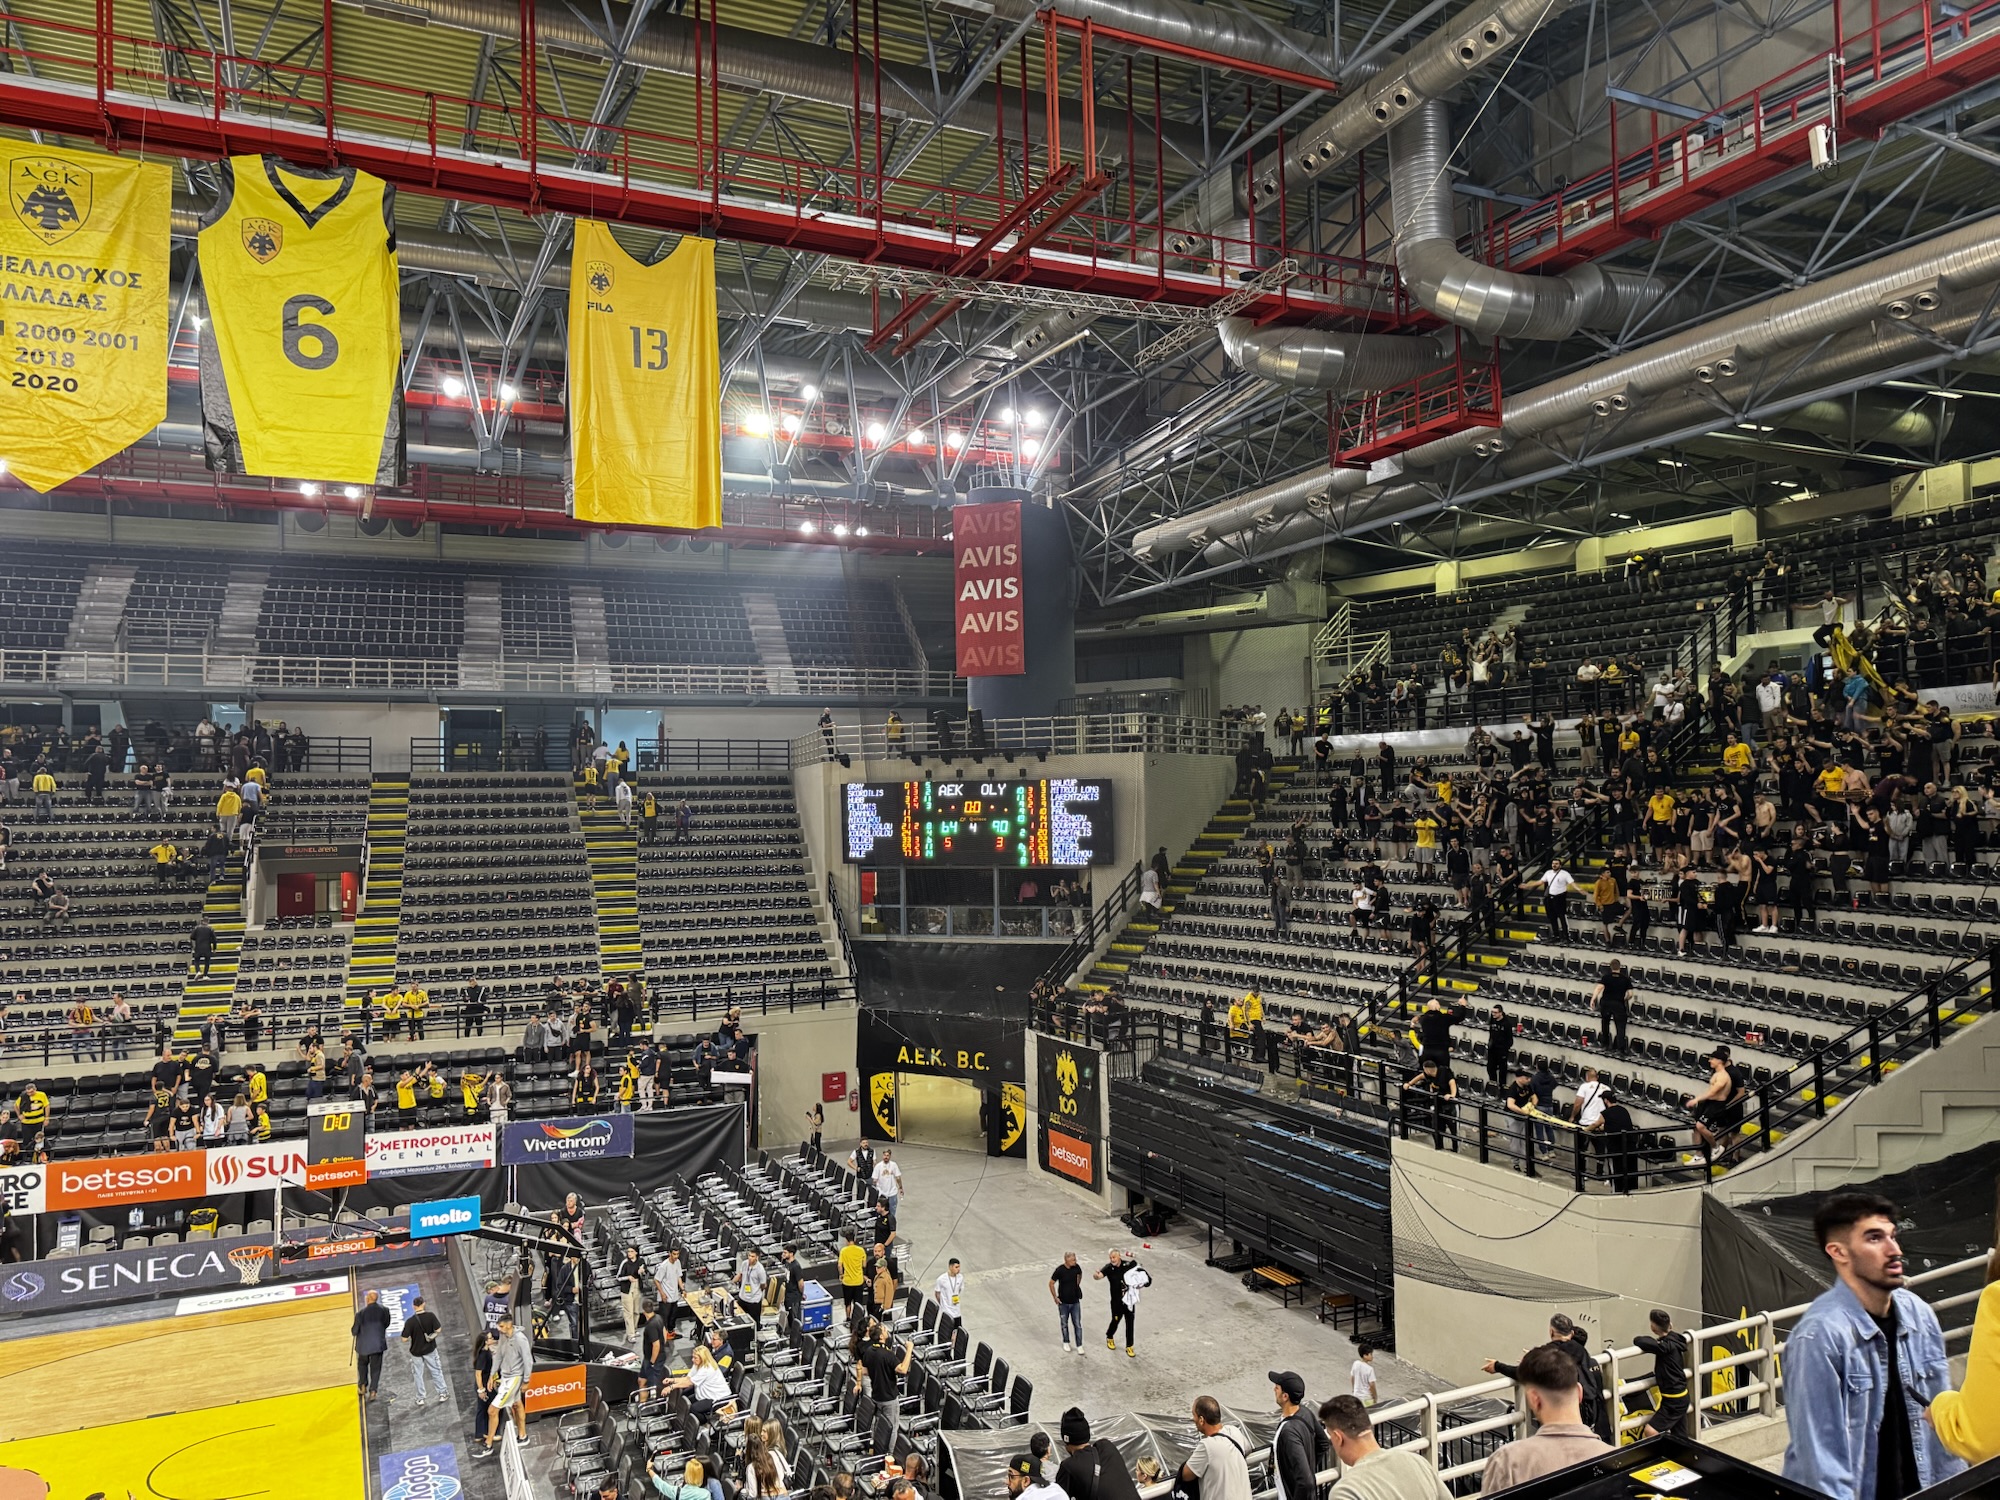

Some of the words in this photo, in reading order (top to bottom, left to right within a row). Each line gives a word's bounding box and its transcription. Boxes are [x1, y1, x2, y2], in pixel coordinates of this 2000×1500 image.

[0, 282, 107, 311] ΛΛΑΔΑΣ
[587, 301, 614, 313] FILA
[15, 321, 76, 344] 2000
[83, 330, 139, 351] 2001
[282, 294, 339, 370] 6
[15, 346, 75, 368] 2018
[629, 326, 669, 371] 13
[11, 371, 78, 393] 2020
[958, 510, 1017, 536] AVIS
[959, 543, 1018, 569] AVIS
[960, 577, 1019, 602] AVIS
[960, 610, 1019, 634] AVIS
[961, 643, 1020, 668] AVIS
[938, 784, 964, 796] AEK
[980, 783, 1007, 795] OLY
[941, 821, 958, 833] 64
[969, 822, 977, 833] 4
[992, 820, 1008, 832] 90
[944, 837, 951, 848] 5
[996, 836, 1004, 848] 3
[897, 1045, 947, 1067] A.E.K.
[957, 1050, 990, 1071] B.C.
[1058, 1095, 1078, 1117] 100
[380, 1131, 492, 1151] METROPOLITAN
[523, 1135, 606, 1152] Vivechrom
[380, 1144, 492, 1161] GENERAL
[560, 1150, 577, 1158] let's
[578, 1148, 605, 1157] colour
[1050, 1142, 1089, 1169] betsson
[61, 1164, 192, 1193] betsson
[309, 1169, 356, 1183] betsson
[420, 1209, 472, 1228] molto
[313, 1241, 366, 1256] betsson
[60, 1251, 226, 1294] SENECA
[197, 1290, 286, 1307] COSMOTE
